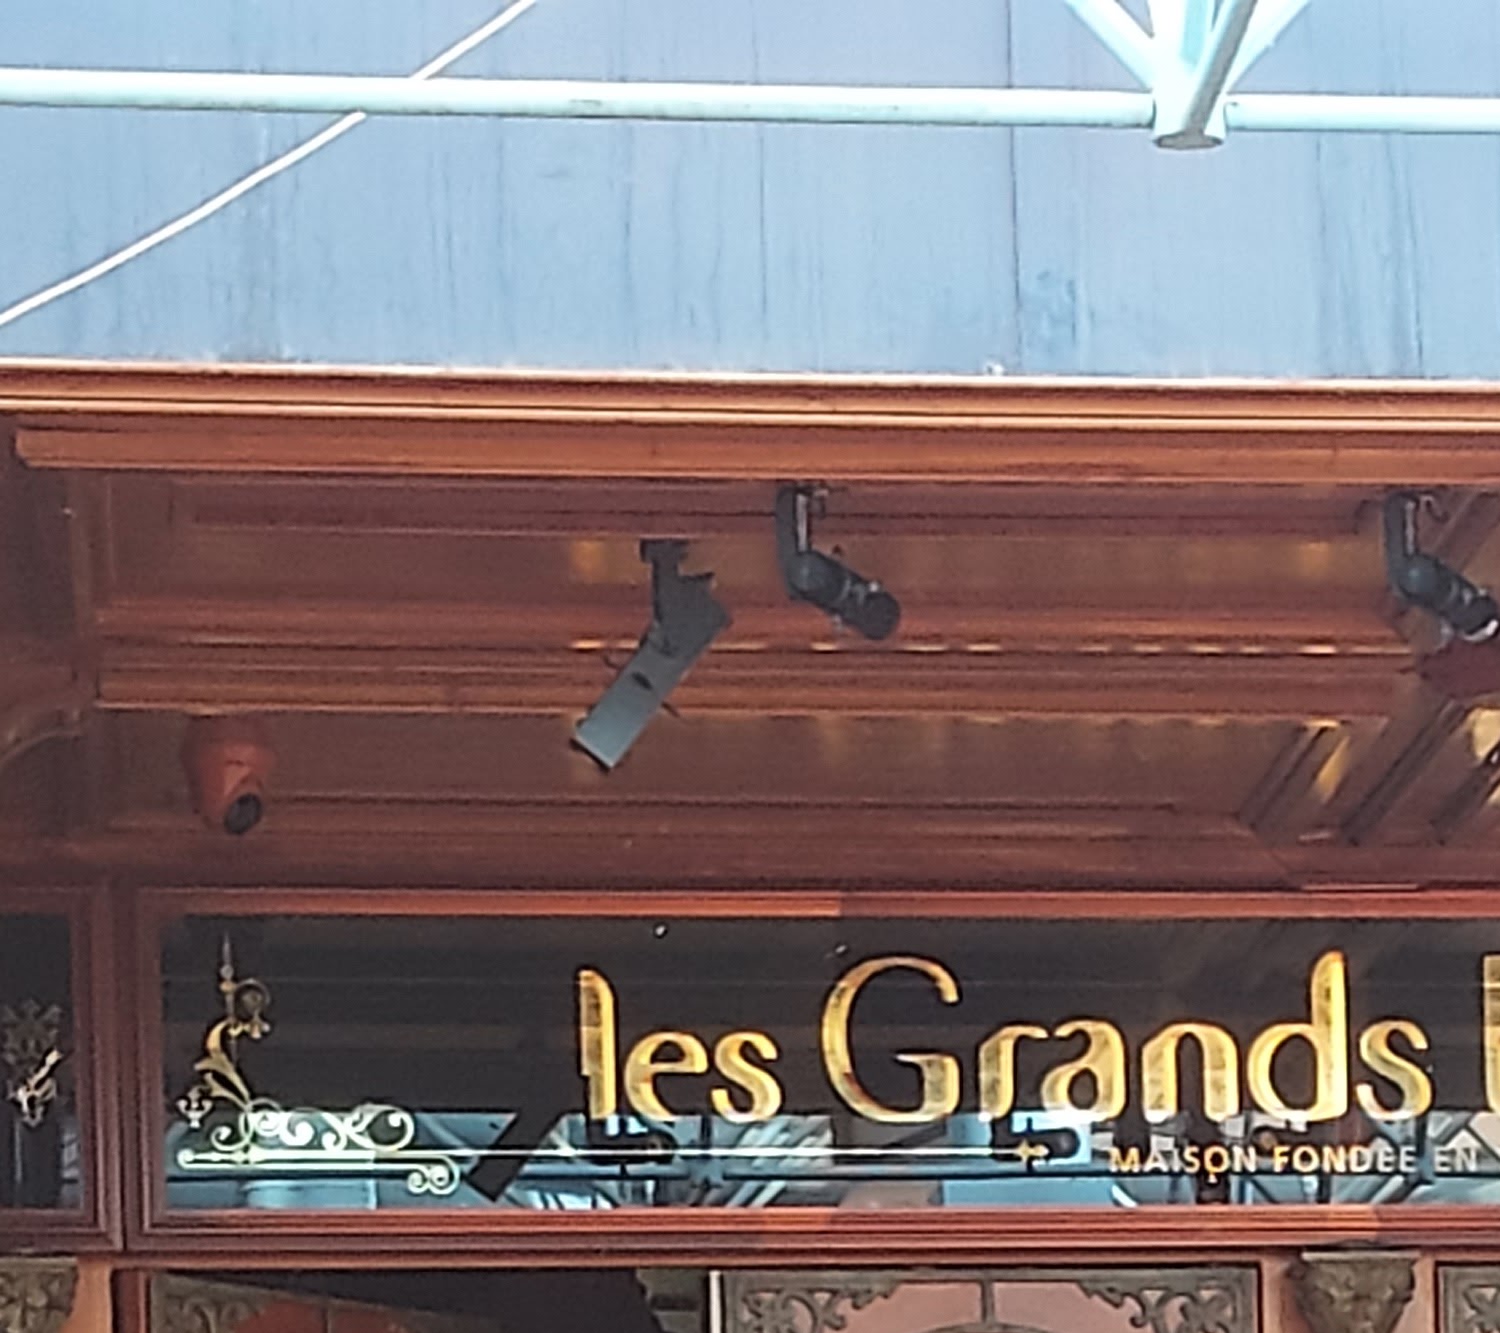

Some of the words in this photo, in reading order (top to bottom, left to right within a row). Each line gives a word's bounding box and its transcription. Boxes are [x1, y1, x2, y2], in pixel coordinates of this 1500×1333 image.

[573, 968, 783, 1123] les
[820, 950, 1434, 1125] Grands
[1108, 1145, 1258, 1174] MAISON
